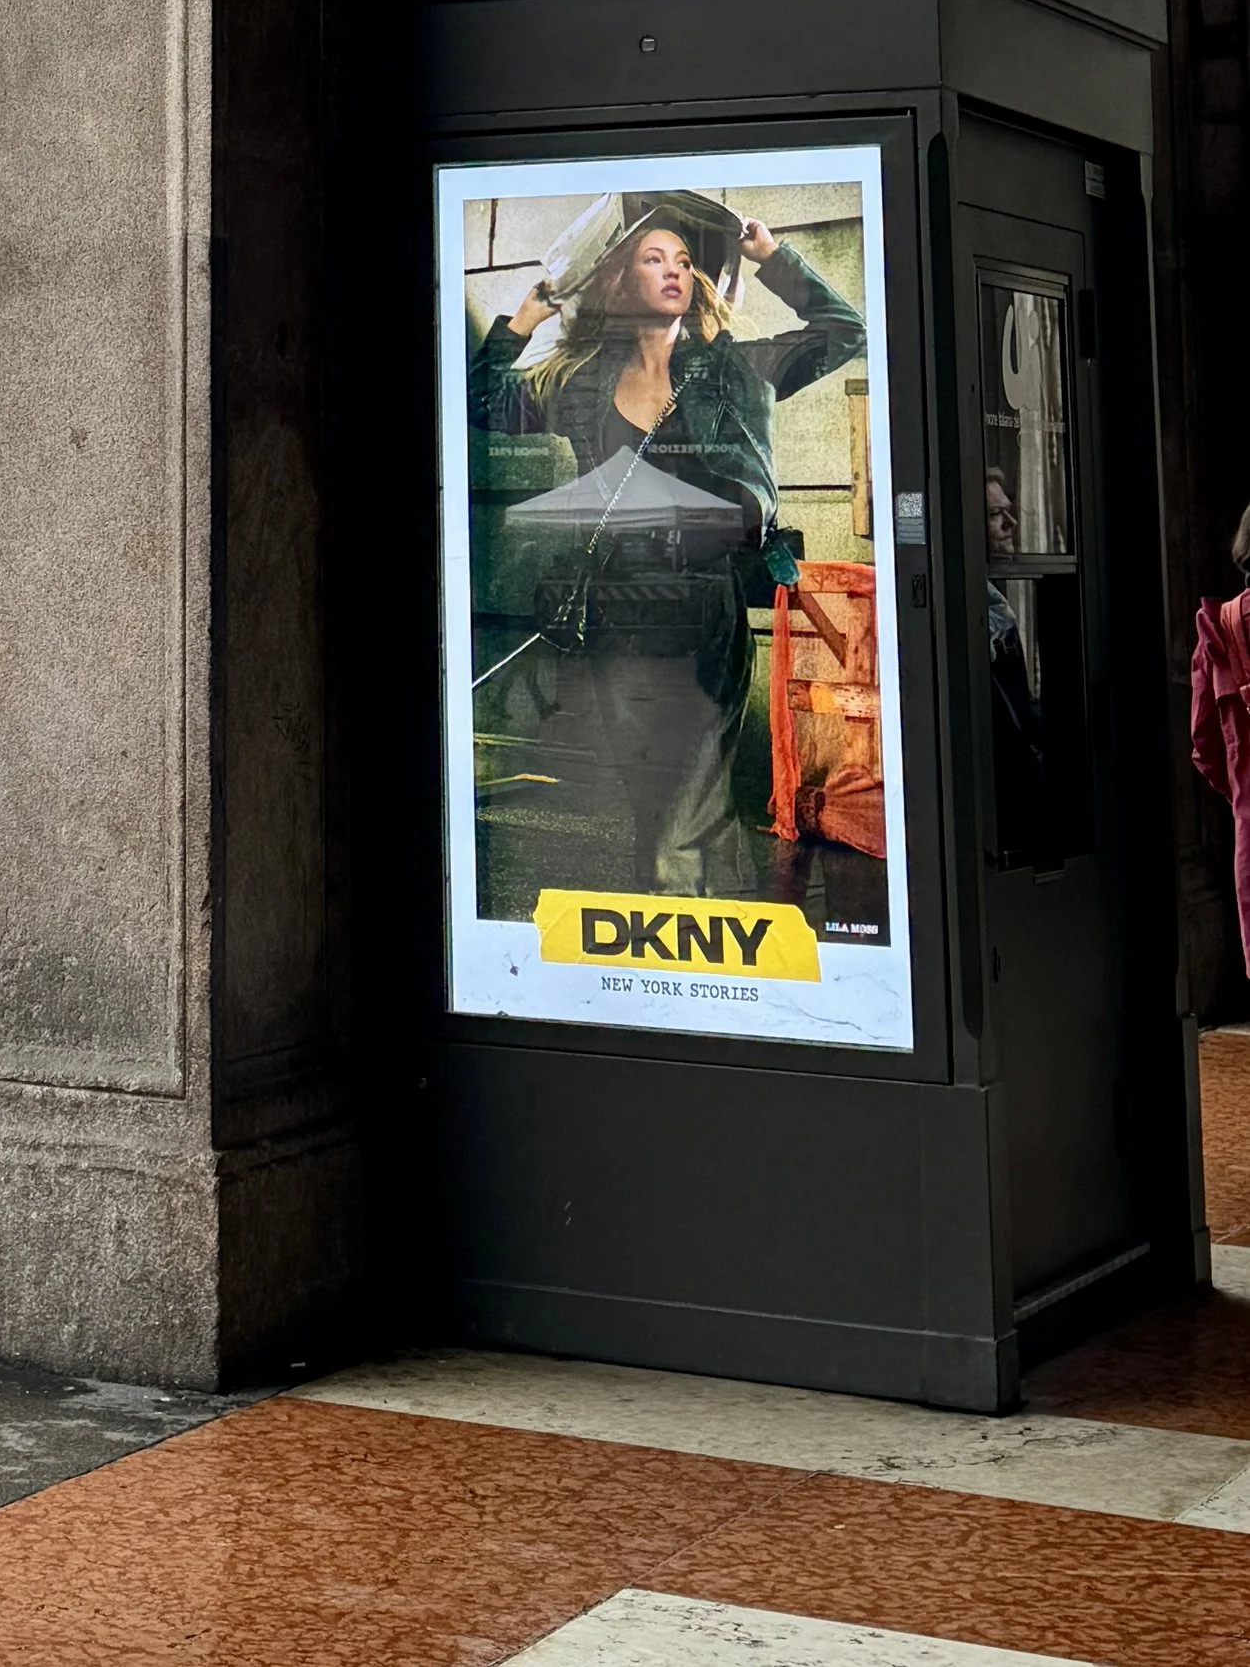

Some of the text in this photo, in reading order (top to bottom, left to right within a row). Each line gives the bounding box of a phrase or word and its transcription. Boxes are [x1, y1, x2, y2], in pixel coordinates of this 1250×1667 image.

[581, 907, 774, 966] DKNY
[825, 921, 849, 933] LILA
[601, 976, 759, 1002] NEW YORK STORIES
